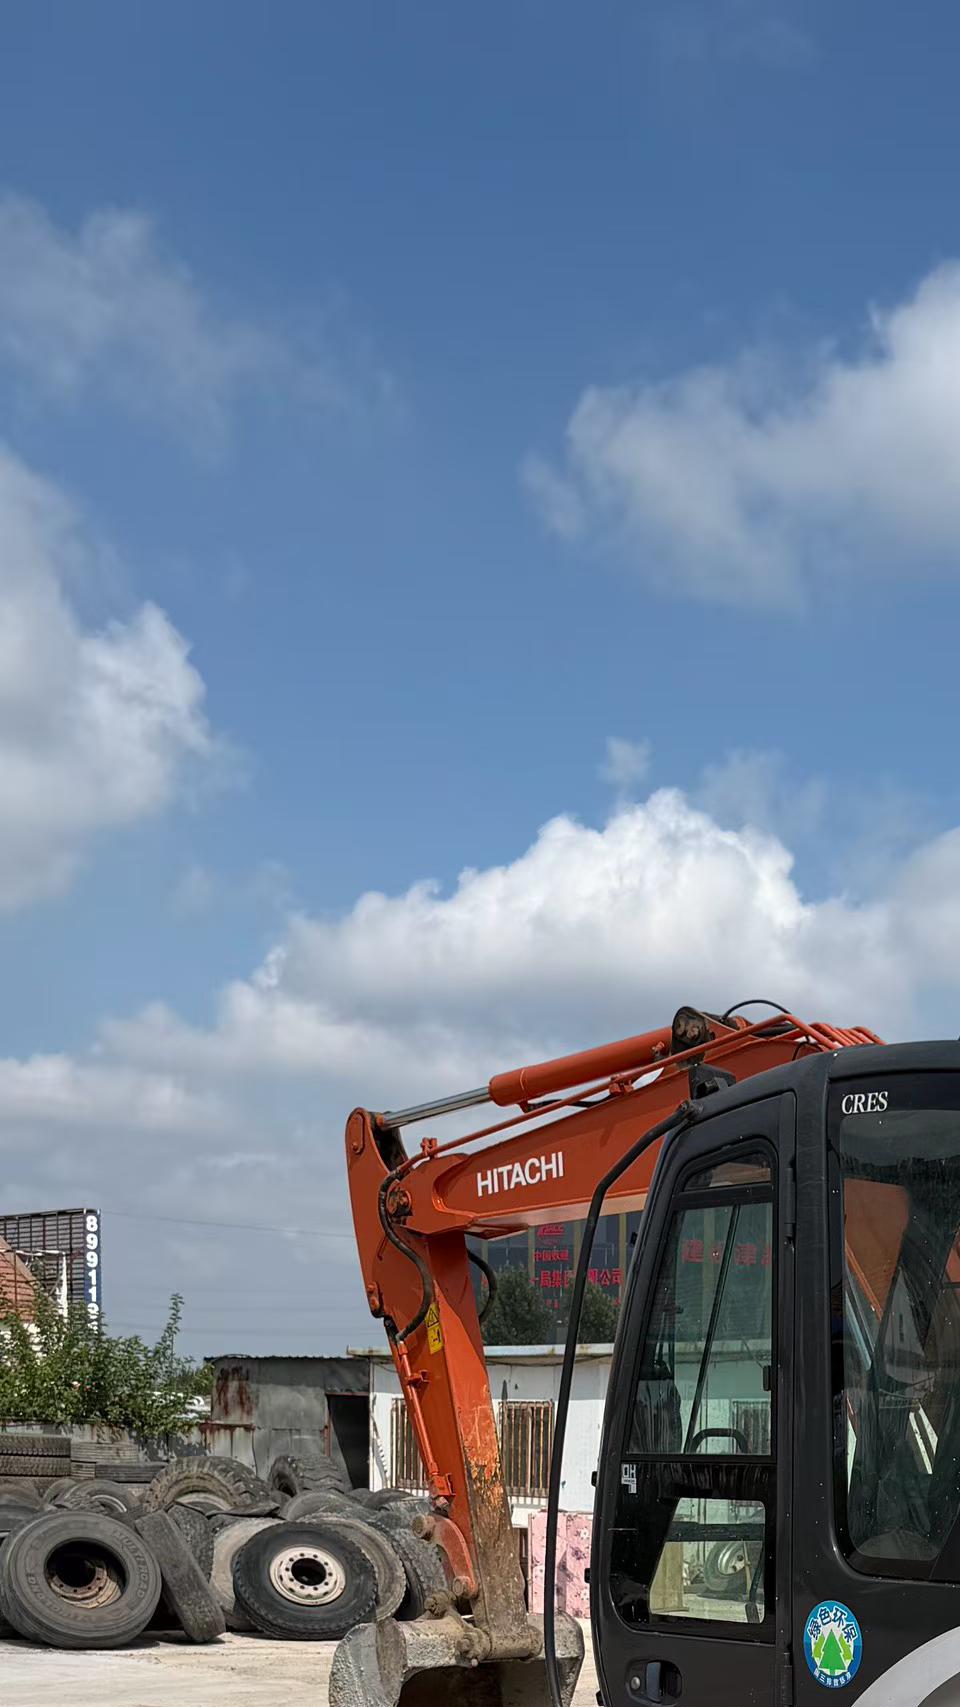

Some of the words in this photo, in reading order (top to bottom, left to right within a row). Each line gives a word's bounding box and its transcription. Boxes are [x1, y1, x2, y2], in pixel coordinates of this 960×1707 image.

[841, 1091, 888, 1115] CRES
[477, 1152, 564, 1197] HITACHI
[807, 1606, 858, 1644] 绿色环保
